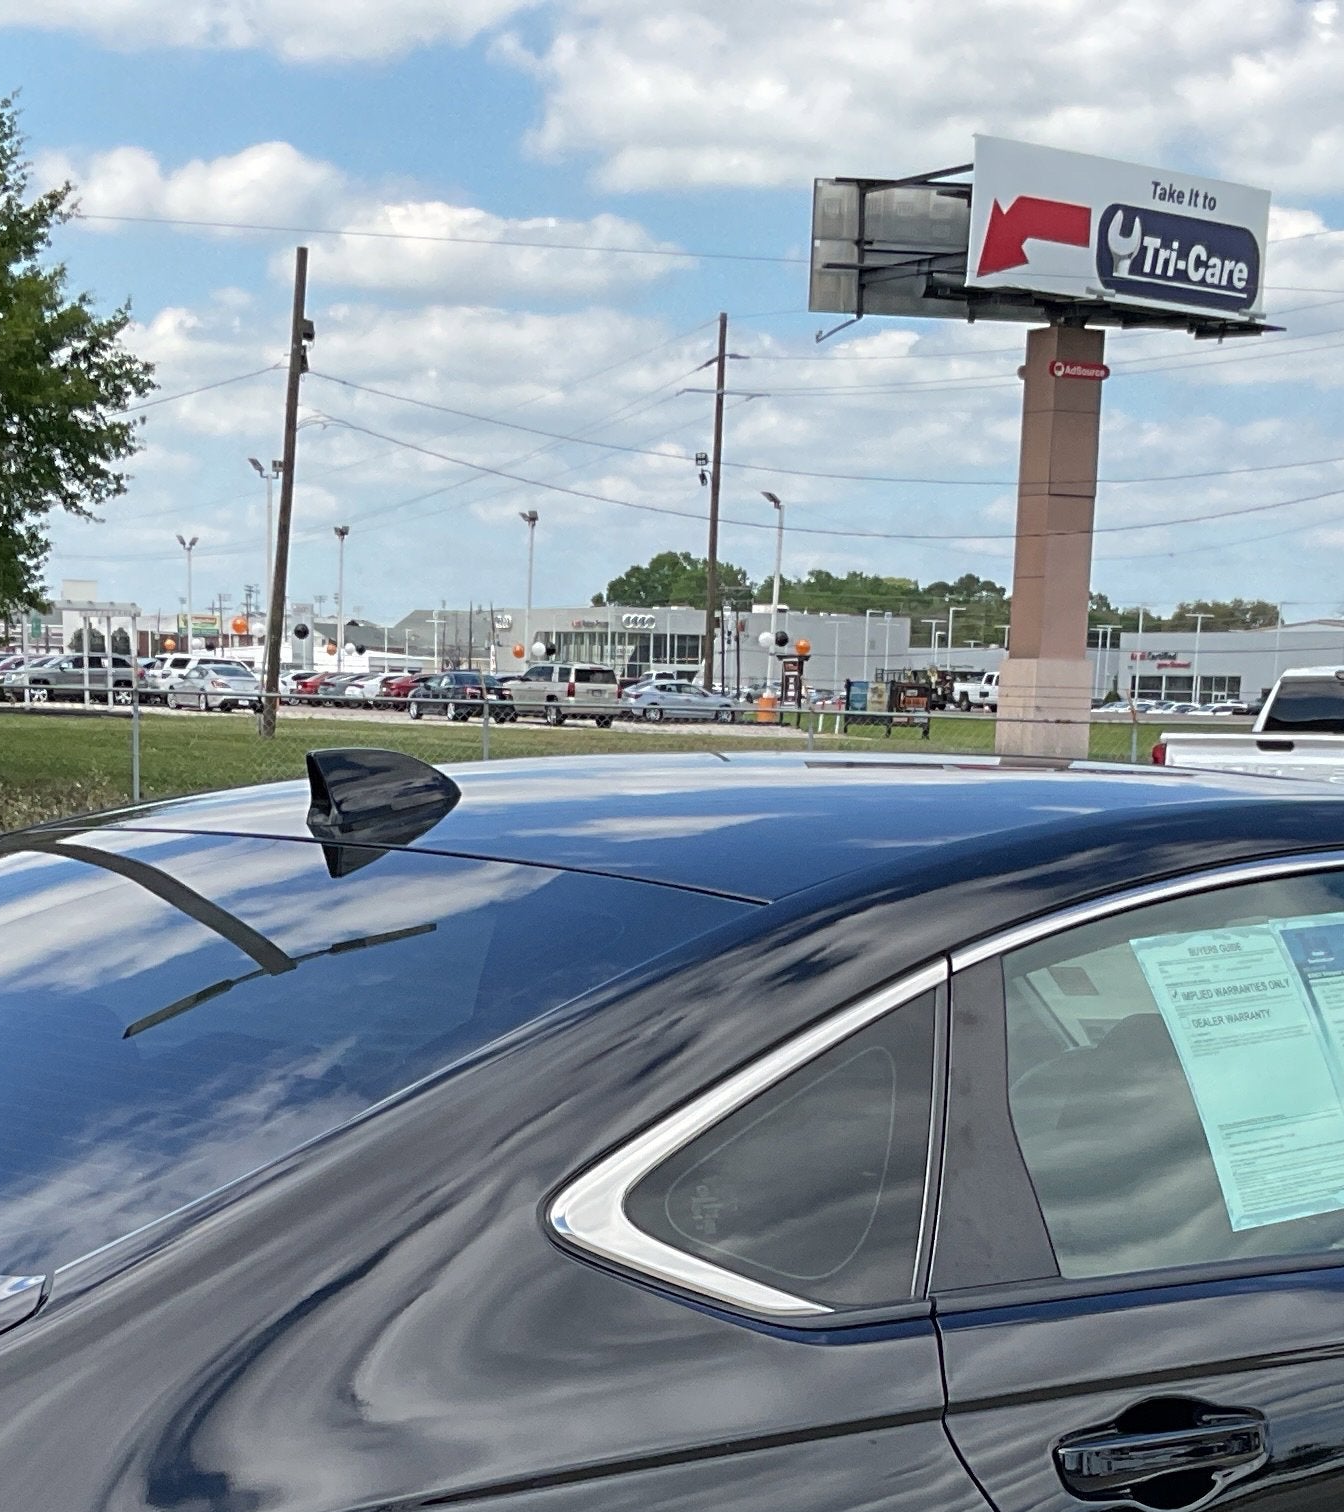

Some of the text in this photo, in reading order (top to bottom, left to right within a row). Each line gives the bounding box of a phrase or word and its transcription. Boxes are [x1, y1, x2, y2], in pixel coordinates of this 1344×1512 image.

[1151, 180, 1217, 211] Take It to
[1142, 235, 1249, 290] Tri-Care
[1187, 942, 1242, 956] BUYERS GUIDE
[1181, 989, 1214, 1001] IMPLIED
[1214, 981, 1268, 998] WARRANTIES
[1268, 978, 1291, 990] ONLY
[1192, 1008, 1272, 1029] DEALER WARRANTY
